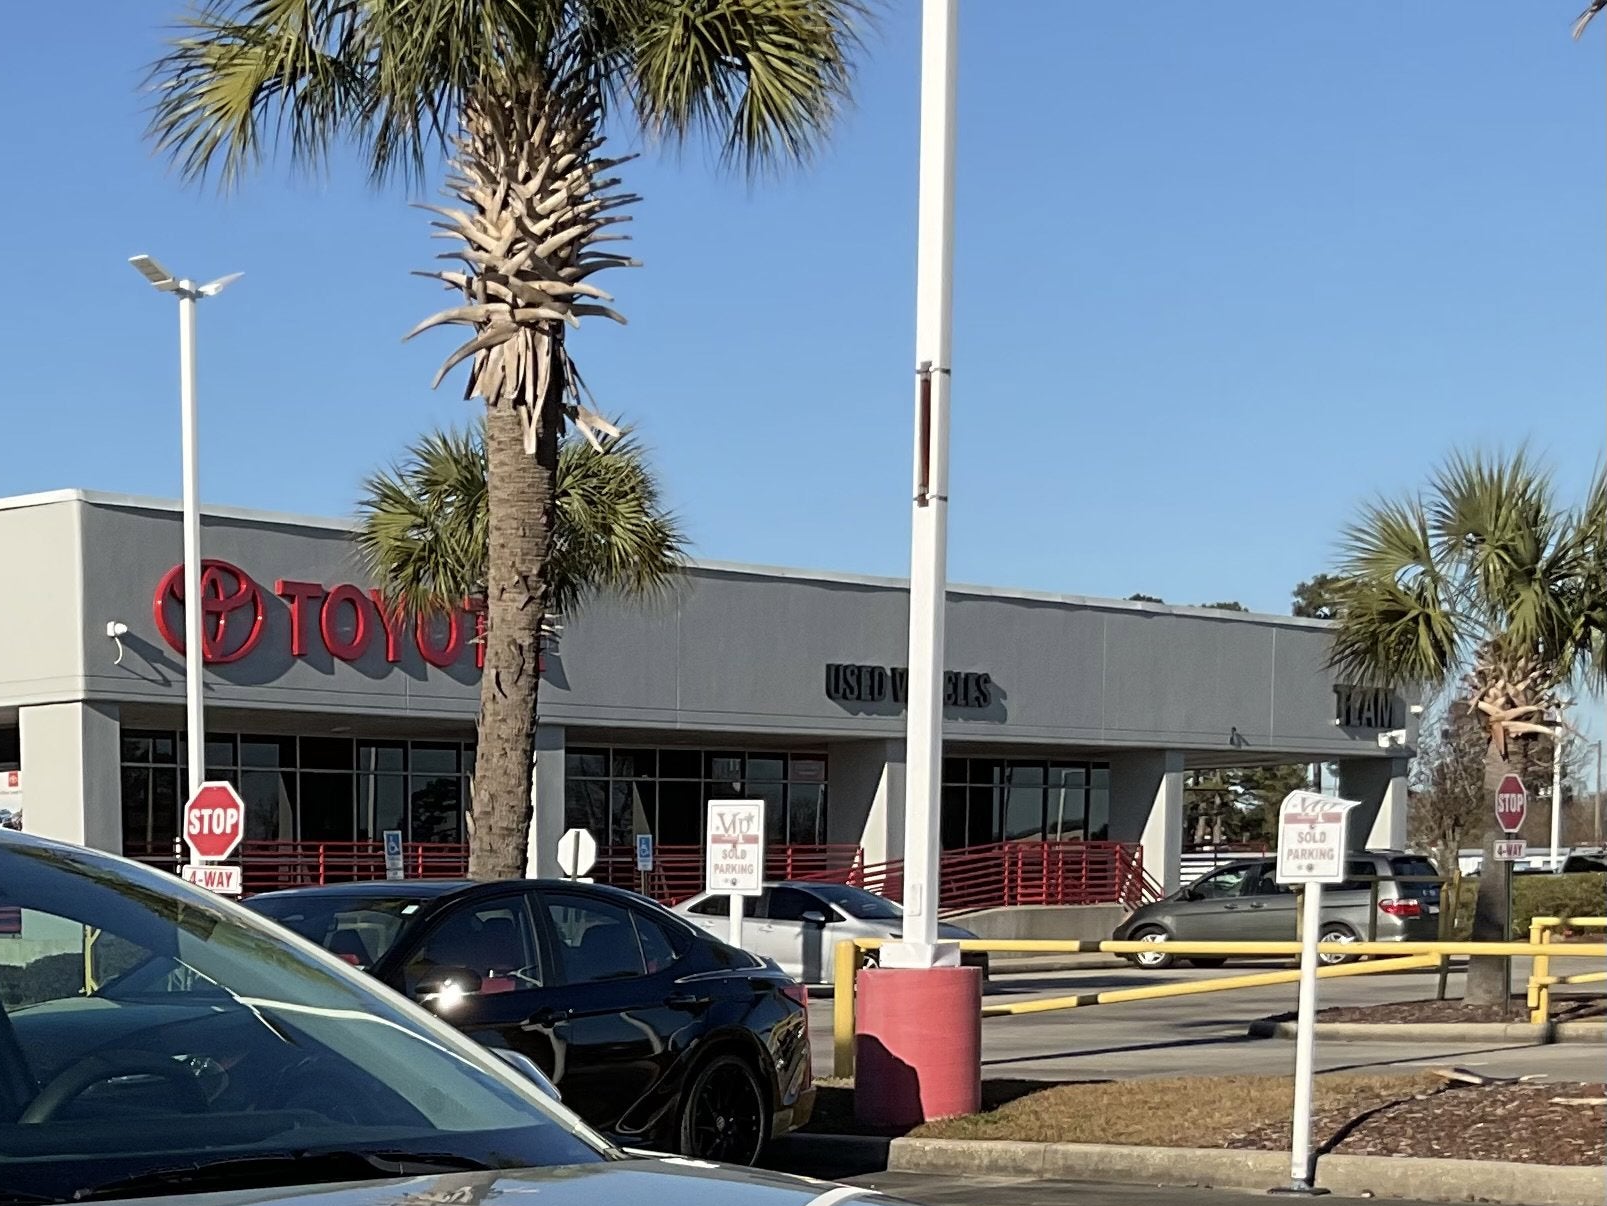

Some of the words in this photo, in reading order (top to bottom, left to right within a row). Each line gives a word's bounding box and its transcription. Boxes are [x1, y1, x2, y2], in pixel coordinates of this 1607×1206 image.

[274, 578, 545, 673] TOYOT
[826, 664, 887, 701] USED
[890, 667, 993, 708] VCLES
[1497, 793, 1524, 813] STOP
[189, 808, 238, 835] STOP
[1297, 831, 1327, 844] SOLD
[721, 849, 747, 860] SOLD
[1286, 848, 1335, 861] PARKING
[1497, 844, 1523, 857] 4-WAY
[713, 863, 754, 875] PARKING
[190, 870, 233, 888] 4-WAY
